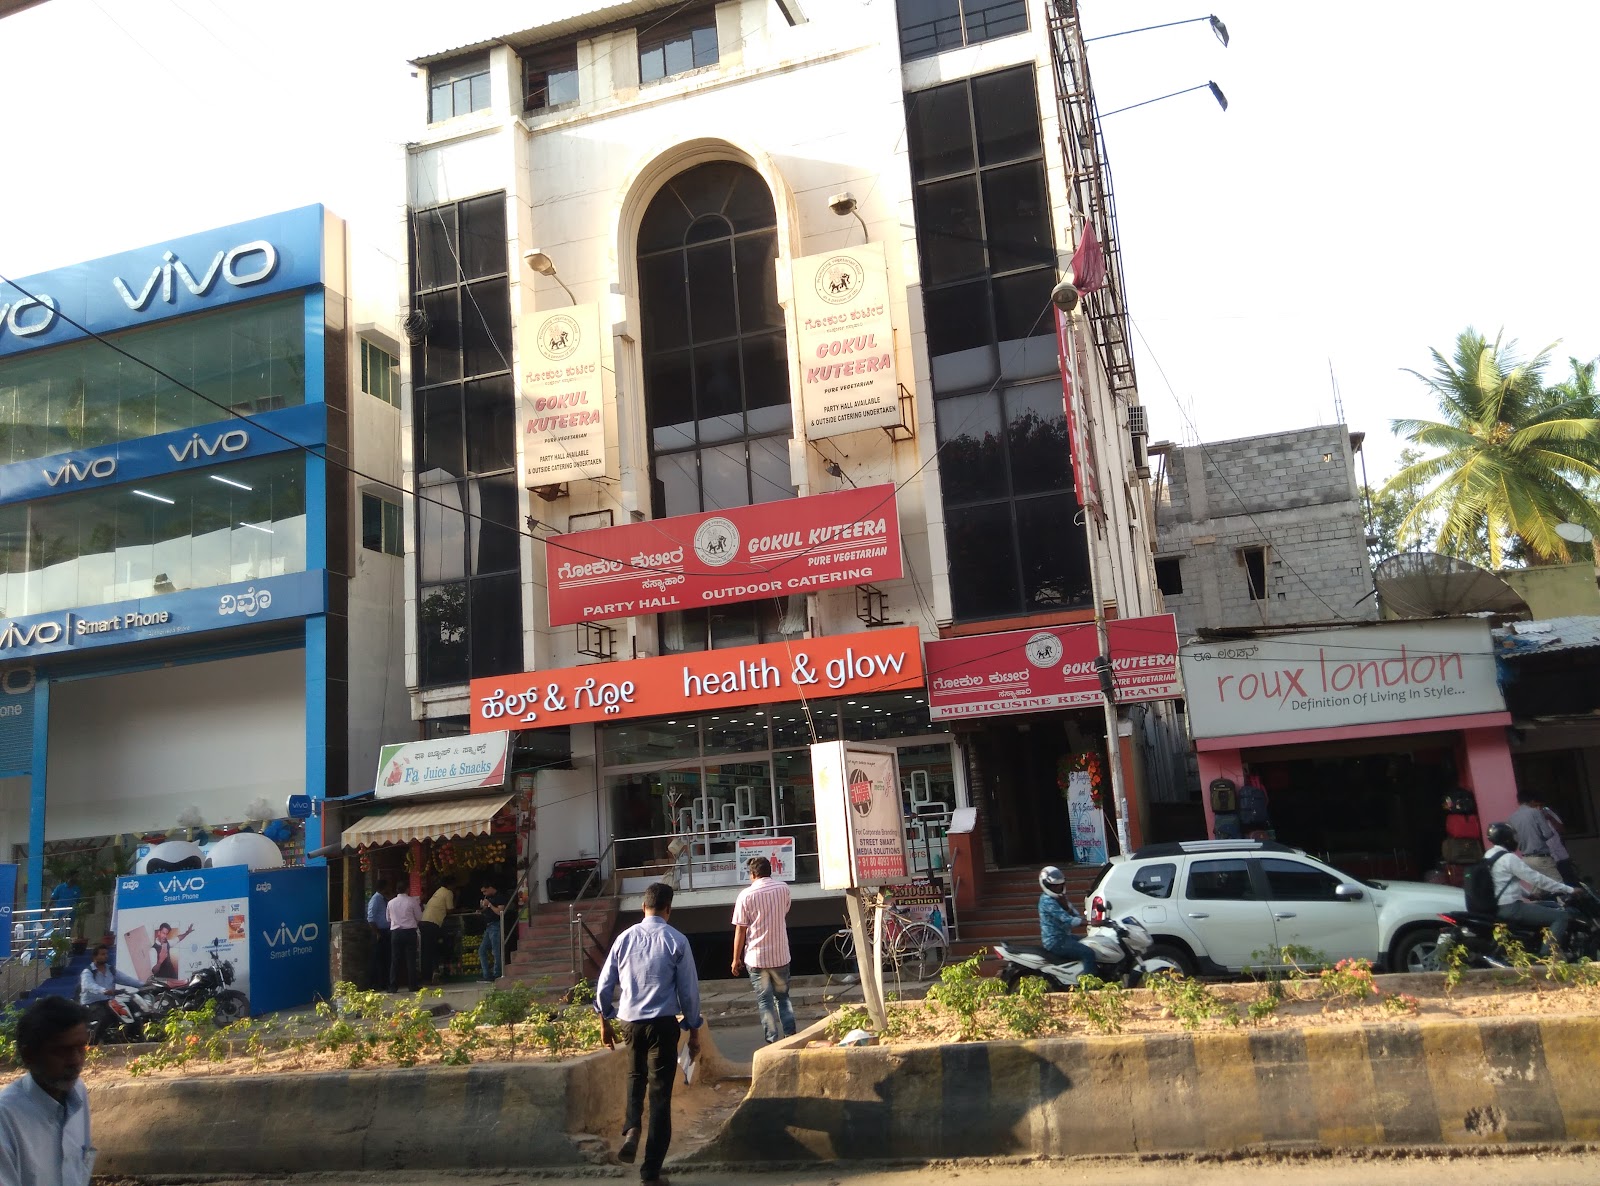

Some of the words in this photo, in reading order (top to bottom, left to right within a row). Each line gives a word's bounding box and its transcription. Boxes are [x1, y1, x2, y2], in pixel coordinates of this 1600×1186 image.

[113, 240, 277, 310] vivo
[816, 333, 878, 359] GOKUL
[807, 353, 891, 384] KUTEERA
[824, 386, 839, 394] PURE
[840, 380, 874, 391] VEGETARIAN
[535, 391, 589, 411] GOKUL
[824, 404, 840, 413] PARTY
[840, 402, 853, 410] HALL
[854, 396, 880, 407] AVAILABLE
[526, 409, 600, 434] KUTEERA
[815, 415, 837, 426] OUTSIDE
[838, 411, 862, 422] CATERING
[863, 405, 897, 417] UNDERTAKEN
[168, 429, 250, 463] vivo
[558, 432, 588, 441] VEGETARIAN
[532, 465, 551, 474] OUTSIDE
[551, 462, 573, 472] CATERING
[573, 458, 602, 469] UNDERTAKEN
[539, 454, 553, 462] PARTY
[553, 452, 566, 460] HALL
[566, 449, 589, 459] AVAILABLE
[42, 456, 117, 487] vivo
[748, 531, 803, 554] GOKUL
[808, 518, 887, 545] KUTEERA
[557, 558, 624, 579] ಗೋಕುಲ
[630, 546, 684, 568] ಕುಟೀರ
[808, 554, 832, 567] PURE
[834, 546, 888, 565] VEGETARIAN
[583, 601, 635, 616] PARTY
[639, 595, 680, 609] HALL
[702, 580, 782, 600] OUTDOOR
[787, 567, 873, 587] CATERING
[642, 574, 685, 592] ಸಸ್ಯಾಹಾರಿ
[76, 615, 121, 635] Smart
[124, 610, 169, 629] Phone
[684, 657, 780, 697] health
[790, 653, 819, 685] &
[825, 647, 906, 690] glow
[1112, 654, 1175, 671] KUTEERA
[933, 675, 984, 690] ಗೋಕುಲ
[988, 668, 1030, 683] ಕುಟೀರ
[1133, 673, 1177, 684] VEGETARIAN
[1216, 668, 1309, 711] roux
[1319, 644, 1464, 693] london
[481, 687, 538, 723] ಹೆಲ್ತ್
[543, 683, 567, 711] &
[998, 688, 1032, 700] ಸಸ್ಯಾಹಾರಿ
[1291, 695, 1350, 712] Definition
[1352, 692, 1368, 706] Of
[1370, 689, 1407, 706] Living
[1409, 688, 1421, 699] In
[1423, 685, 1465, 699] Style...
[941, 697, 1051, 715] MULTICUSINE
[404, 767, 419, 782] Fa
[424, 765, 447, 780] Juice
[449, 763, 457, 776] &
[459, 760, 491, 775] Snacks
[862, 857, 869, 867] 91
[870, 857, 877, 867] 80
[890, 856, 902, 866] 1111
[159, 875, 205, 893] vivo
[182, 893, 200, 901] Phone
[262, 921, 319, 948] vivo
[270, 949, 291, 960] Smart
[293, 945, 313, 957] Phone
